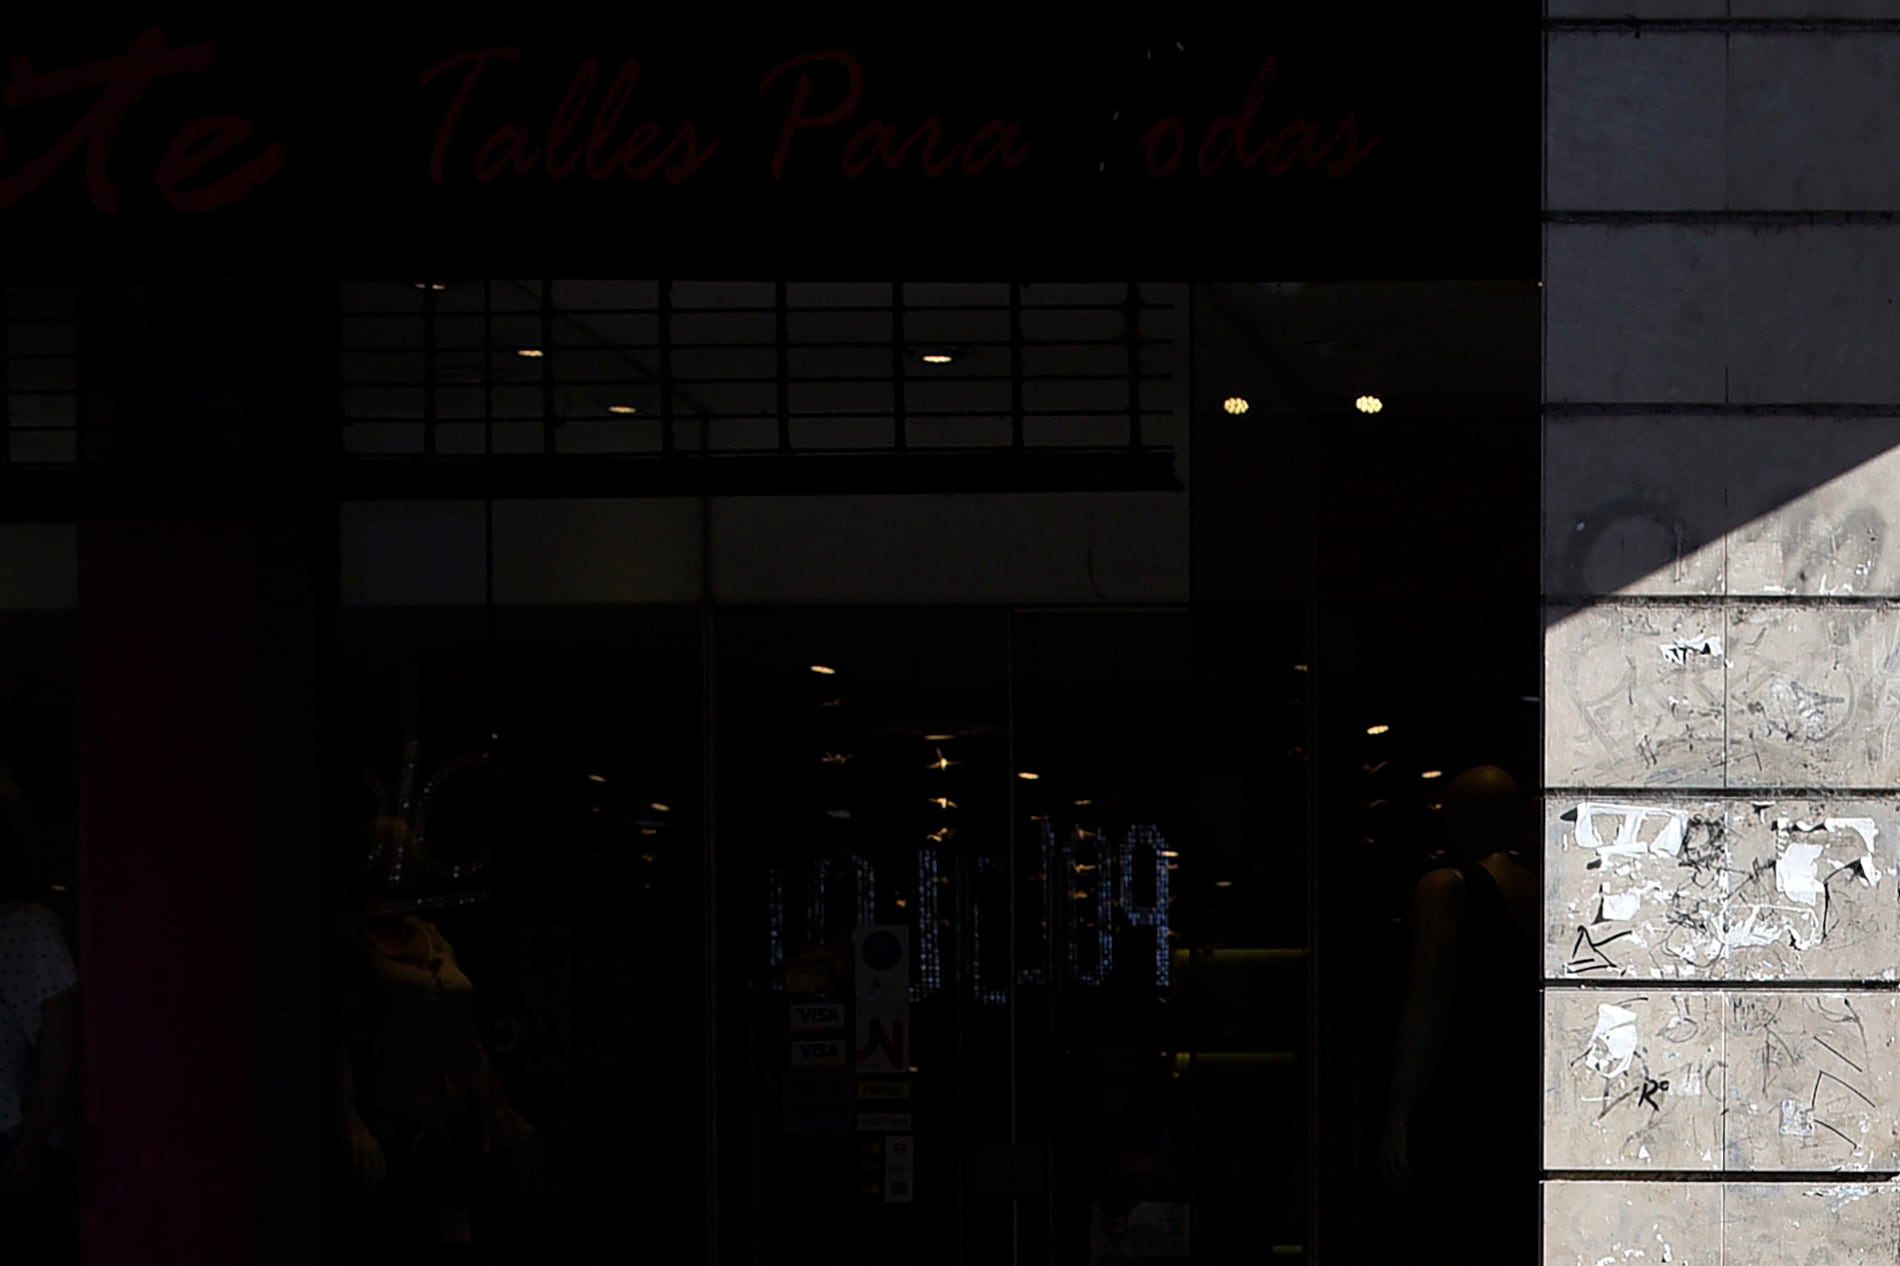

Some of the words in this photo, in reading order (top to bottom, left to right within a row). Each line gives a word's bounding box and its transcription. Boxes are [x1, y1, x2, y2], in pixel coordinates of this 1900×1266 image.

[0, 22, 290, 217] te
[415, 44, 722, 188] Talles
[756, 47, 1037, 184] Para
[799, 1008, 838, 1023] VISA
[800, 1043, 838, 1058] VISA
